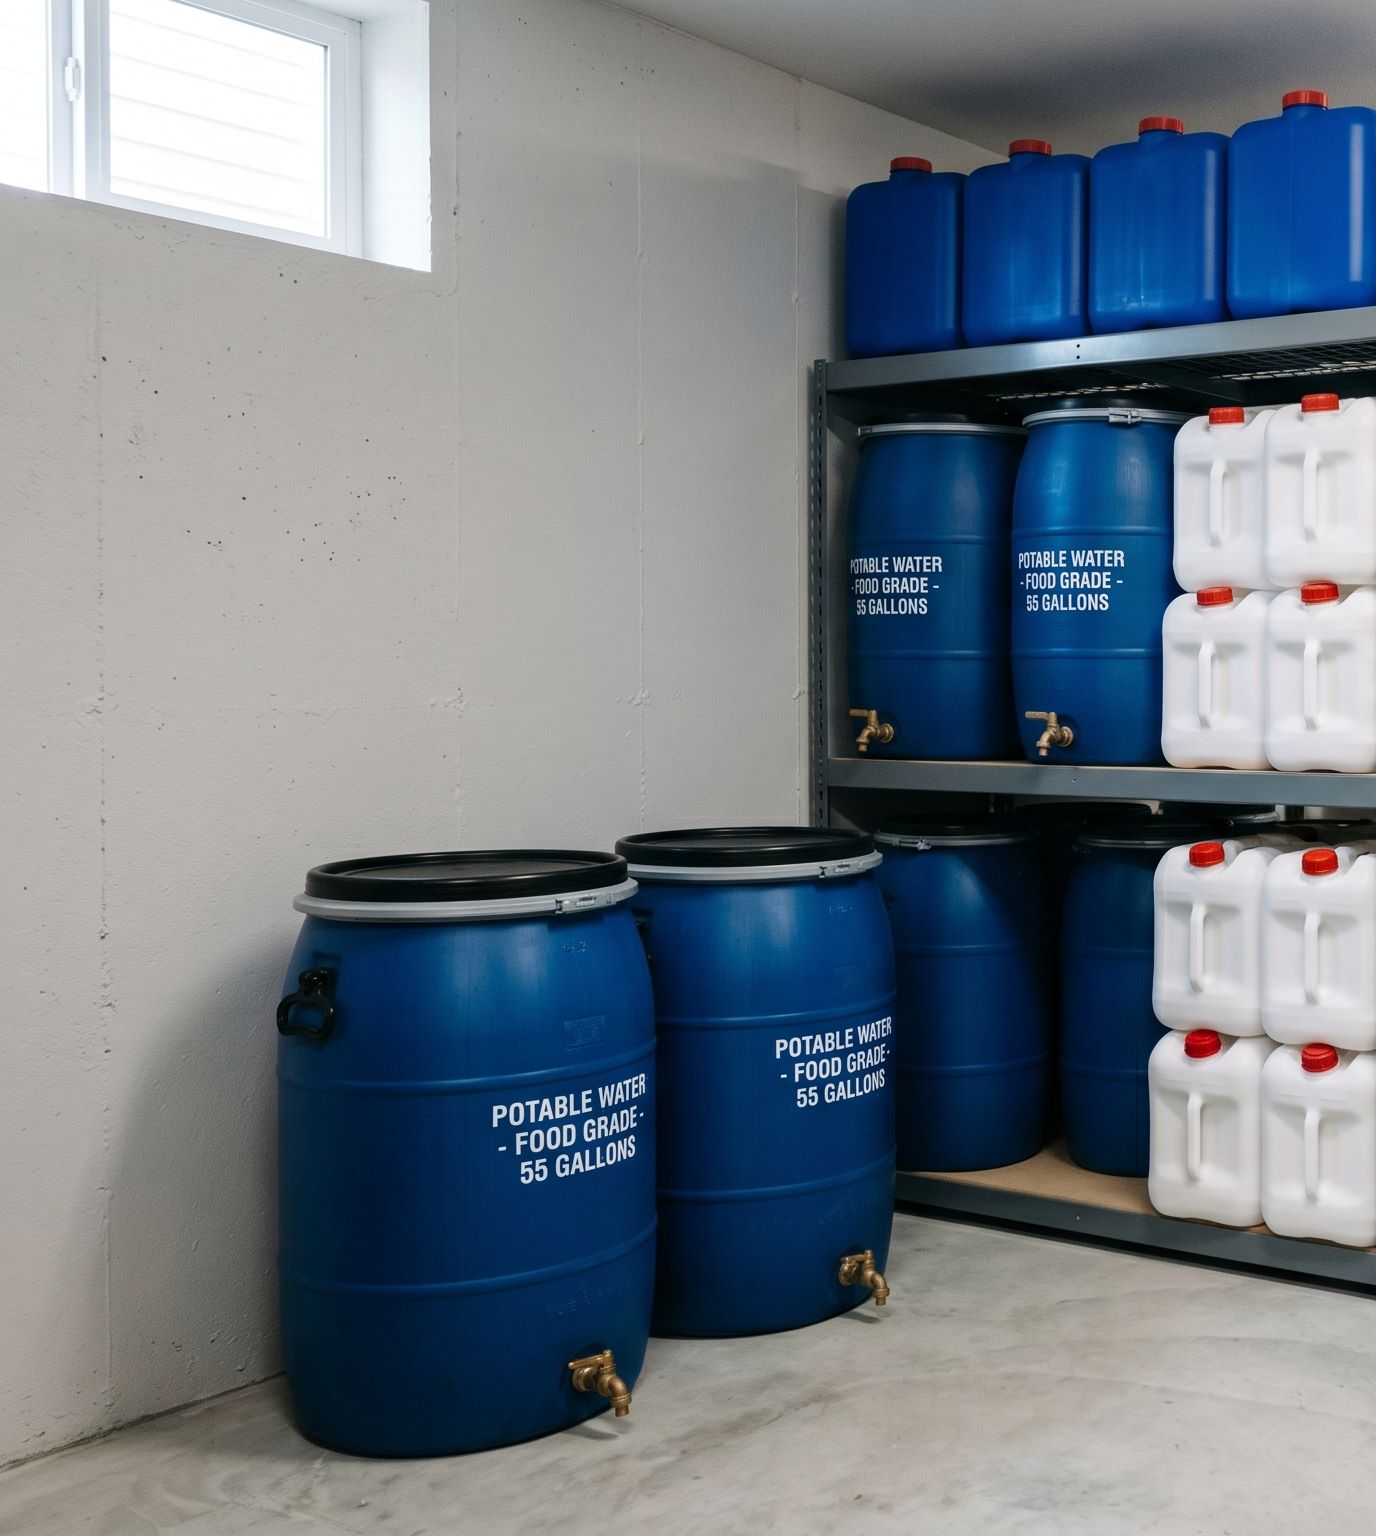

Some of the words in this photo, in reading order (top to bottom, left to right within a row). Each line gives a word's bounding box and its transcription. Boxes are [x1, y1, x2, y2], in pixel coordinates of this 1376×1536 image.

[850, 557, 889, 575] POTABLE
[892, 556, 943, 573] WATER
[1018, 550, 1067, 569] POTABLE
[1070, 549, 1125, 568] WATER
[855, 577, 879, 595] FOOD
[881, 576, 929, 594] GRADE
[1025, 572, 1056, 590] FOOD
[1059, 571, 1112, 589] GRADE
[856, 599, 867, 616] 55
[868, 597, 928, 615] GALLONS
[1026, 594, 1039, 612] 55
[1041, 593, 1110, 612] GALLONS
[775, 1028, 854, 1060] POTABLE
[857, 1016, 892, 1045] WATER
[794, 1056, 842, 1083] FOOD
[846, 1047, 886, 1073] GRADE
[492, 1089, 594, 1128] POTABLE
[597, 1073, 646, 1109] WATER
[796, 1085, 819, 1108] 55
[823, 1068, 886, 1104] GALLONS
[515, 1123, 577, 1156] FOOD
[582, 1105, 638, 1142] GRADE
[520, 1158, 549, 1185] 55
[555, 1134, 636, 1178] GALLONS
